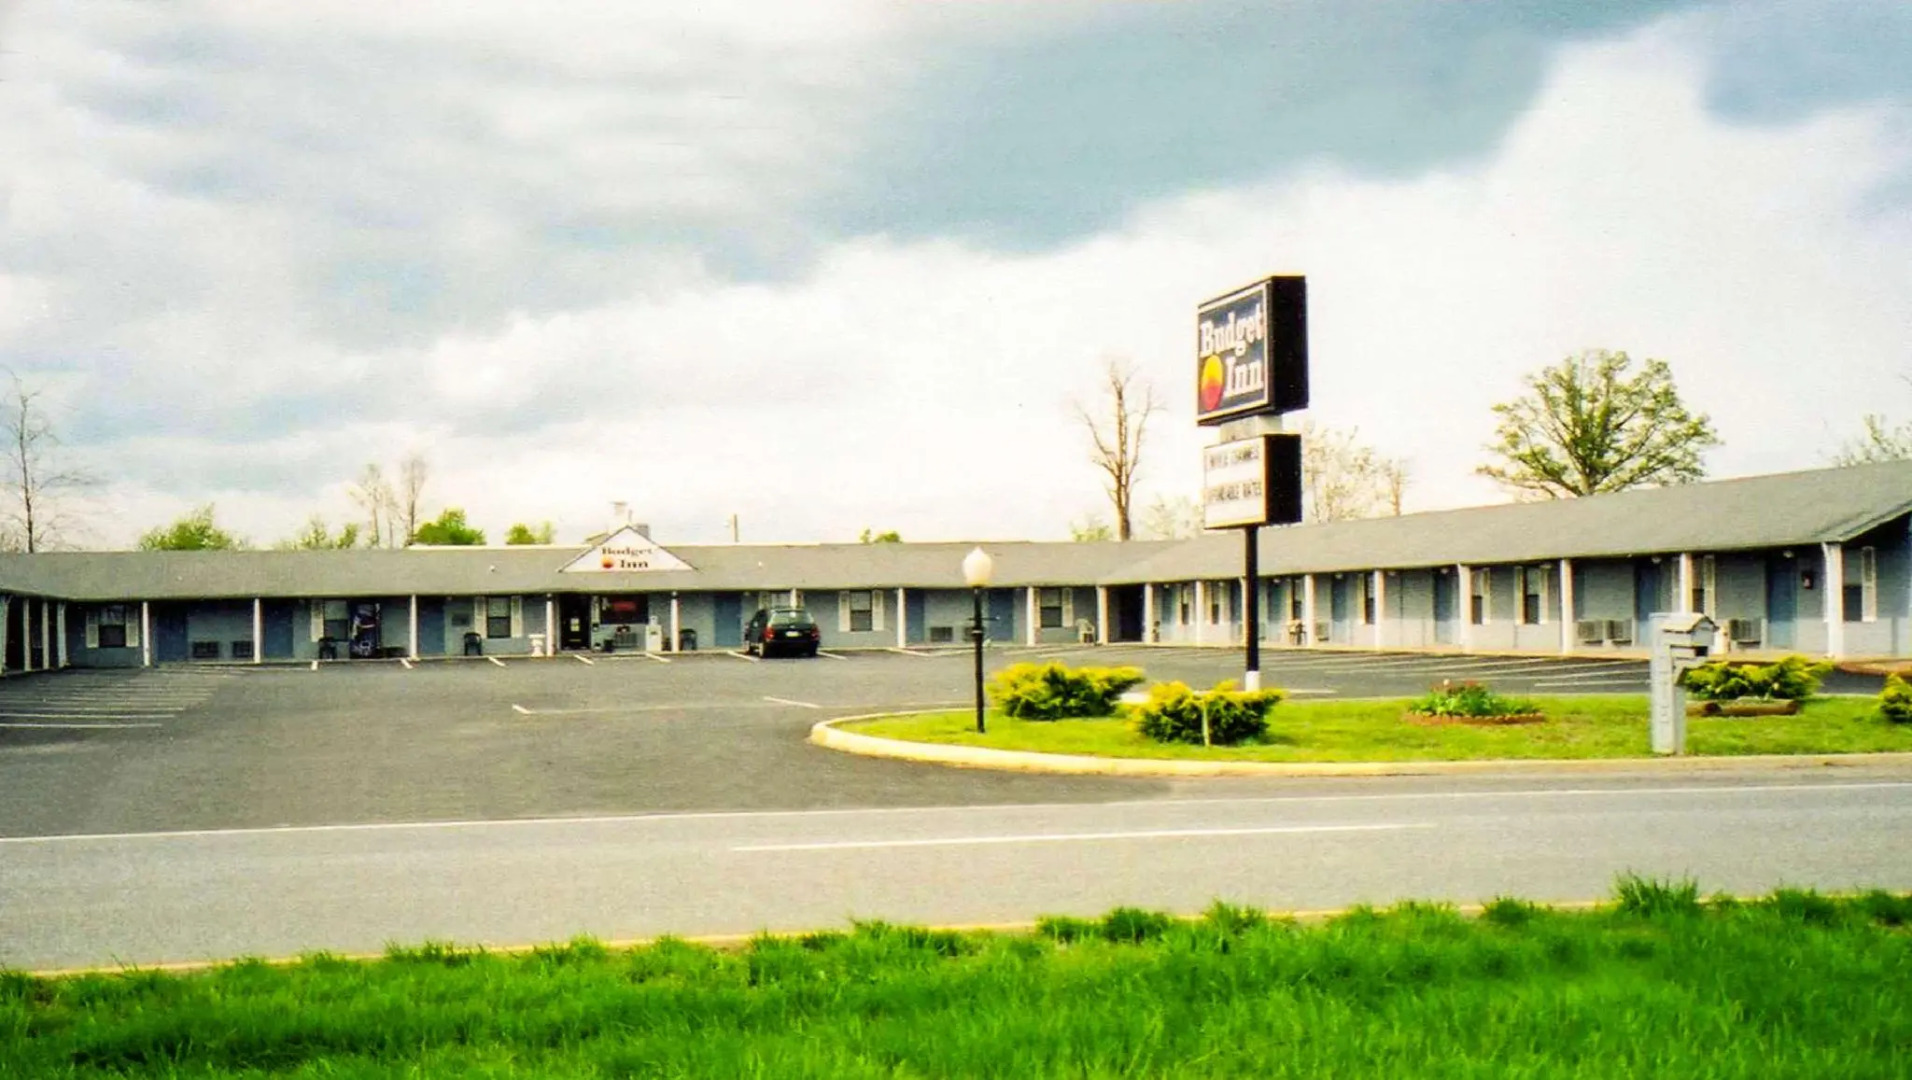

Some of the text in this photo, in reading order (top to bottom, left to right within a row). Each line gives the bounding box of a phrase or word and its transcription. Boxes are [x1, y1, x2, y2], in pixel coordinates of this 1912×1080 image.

[1200, 302, 1263, 358] Budget
[1223, 356, 1263, 399] Inn
[601, 546, 653, 557] Budget
[620, 559, 649, 569] Inn
